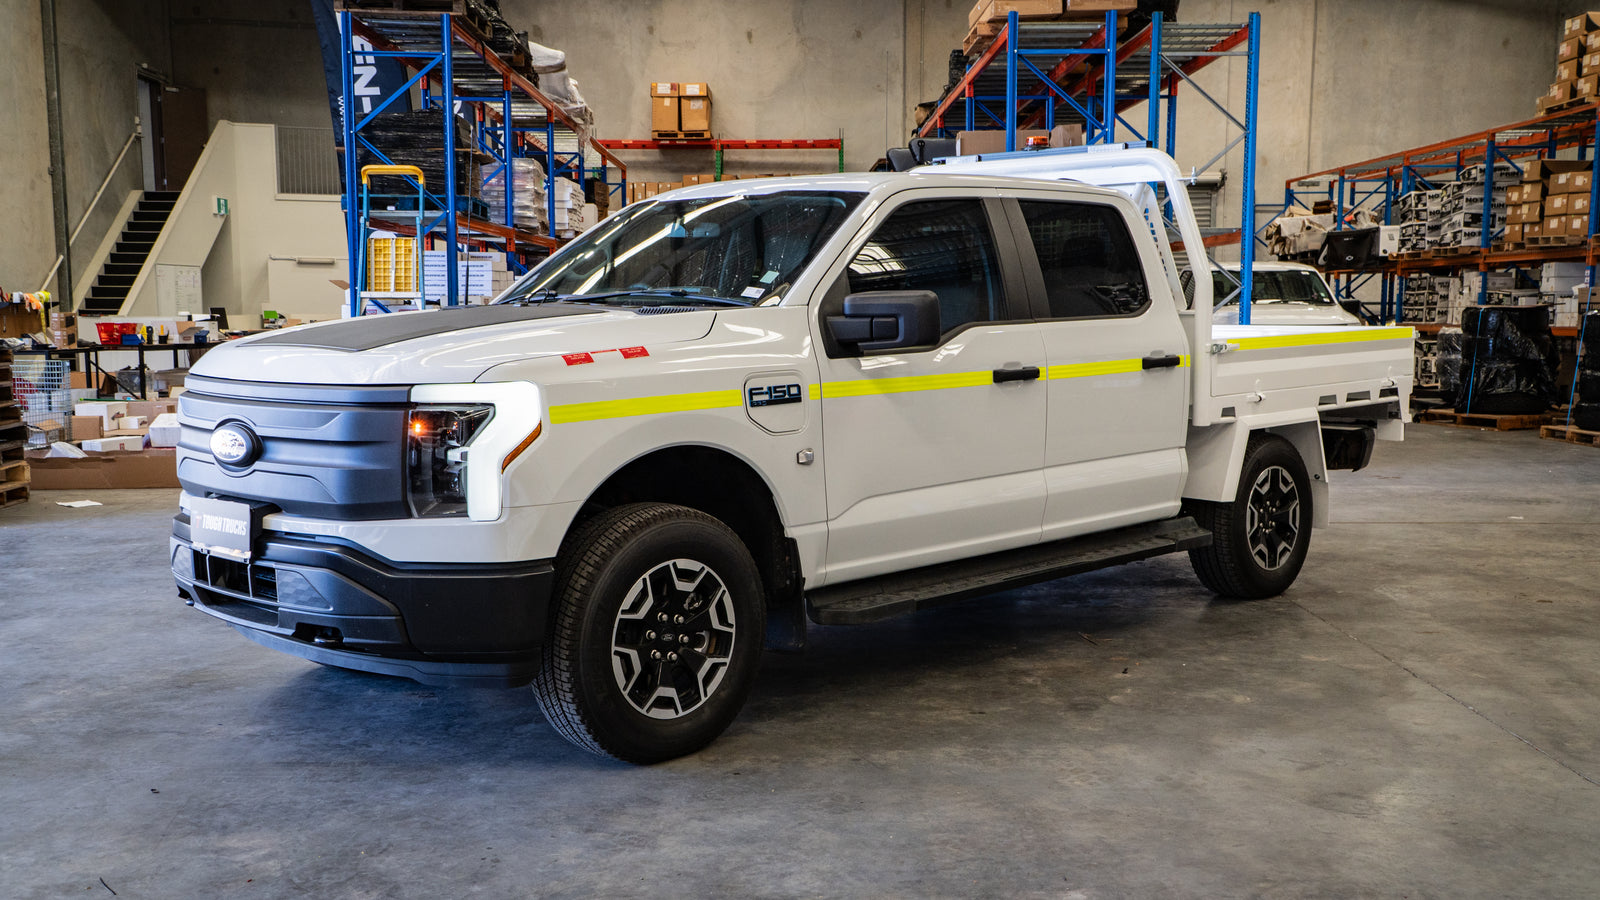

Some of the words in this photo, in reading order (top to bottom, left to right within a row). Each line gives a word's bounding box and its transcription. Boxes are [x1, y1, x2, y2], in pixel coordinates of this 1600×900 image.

[748, 383, 802, 403] F-150
[202, 514, 223, 532] TOUGH
[222, 517, 247, 536] TRUCKS
